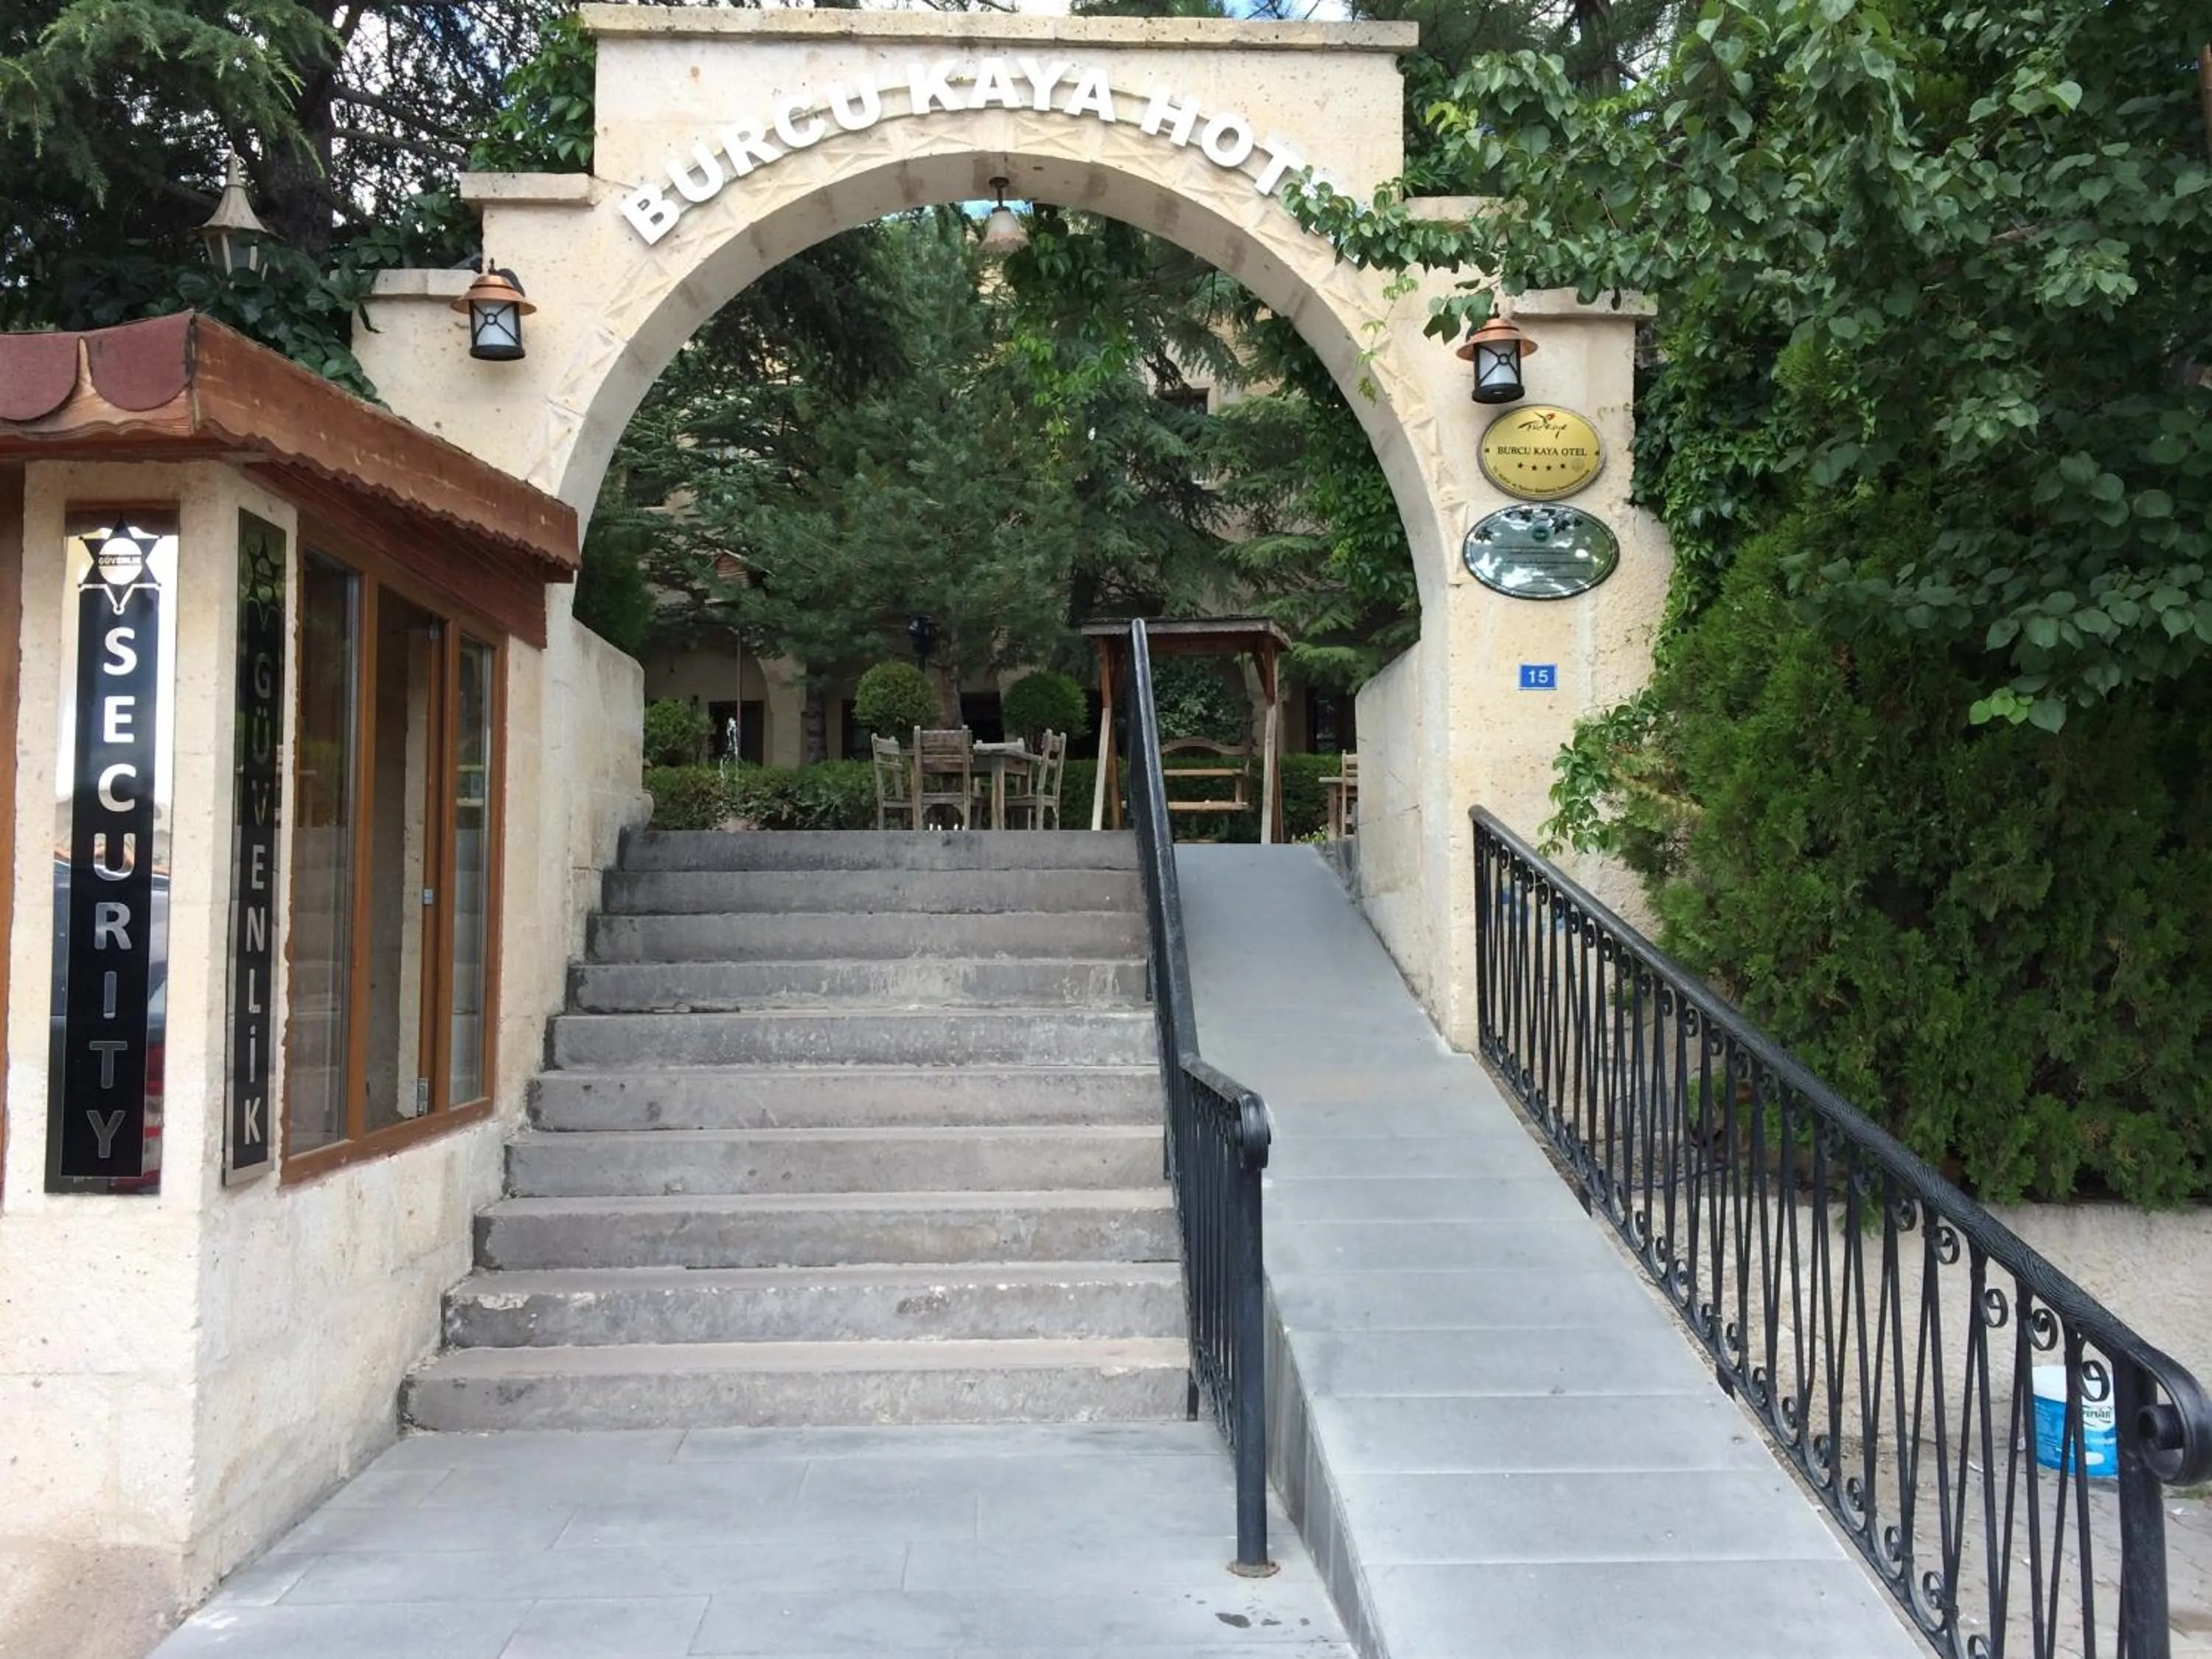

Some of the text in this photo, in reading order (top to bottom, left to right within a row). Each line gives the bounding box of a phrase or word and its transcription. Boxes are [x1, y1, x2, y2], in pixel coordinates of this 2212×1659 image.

[619, 57, 1366, 265] BURCU KAYA HOT
[1498, 446, 1587, 456] BURCU KAYA OTEL
[1528, 669, 1549, 684] 15
[86, 626, 139, 1160] SECURITY
